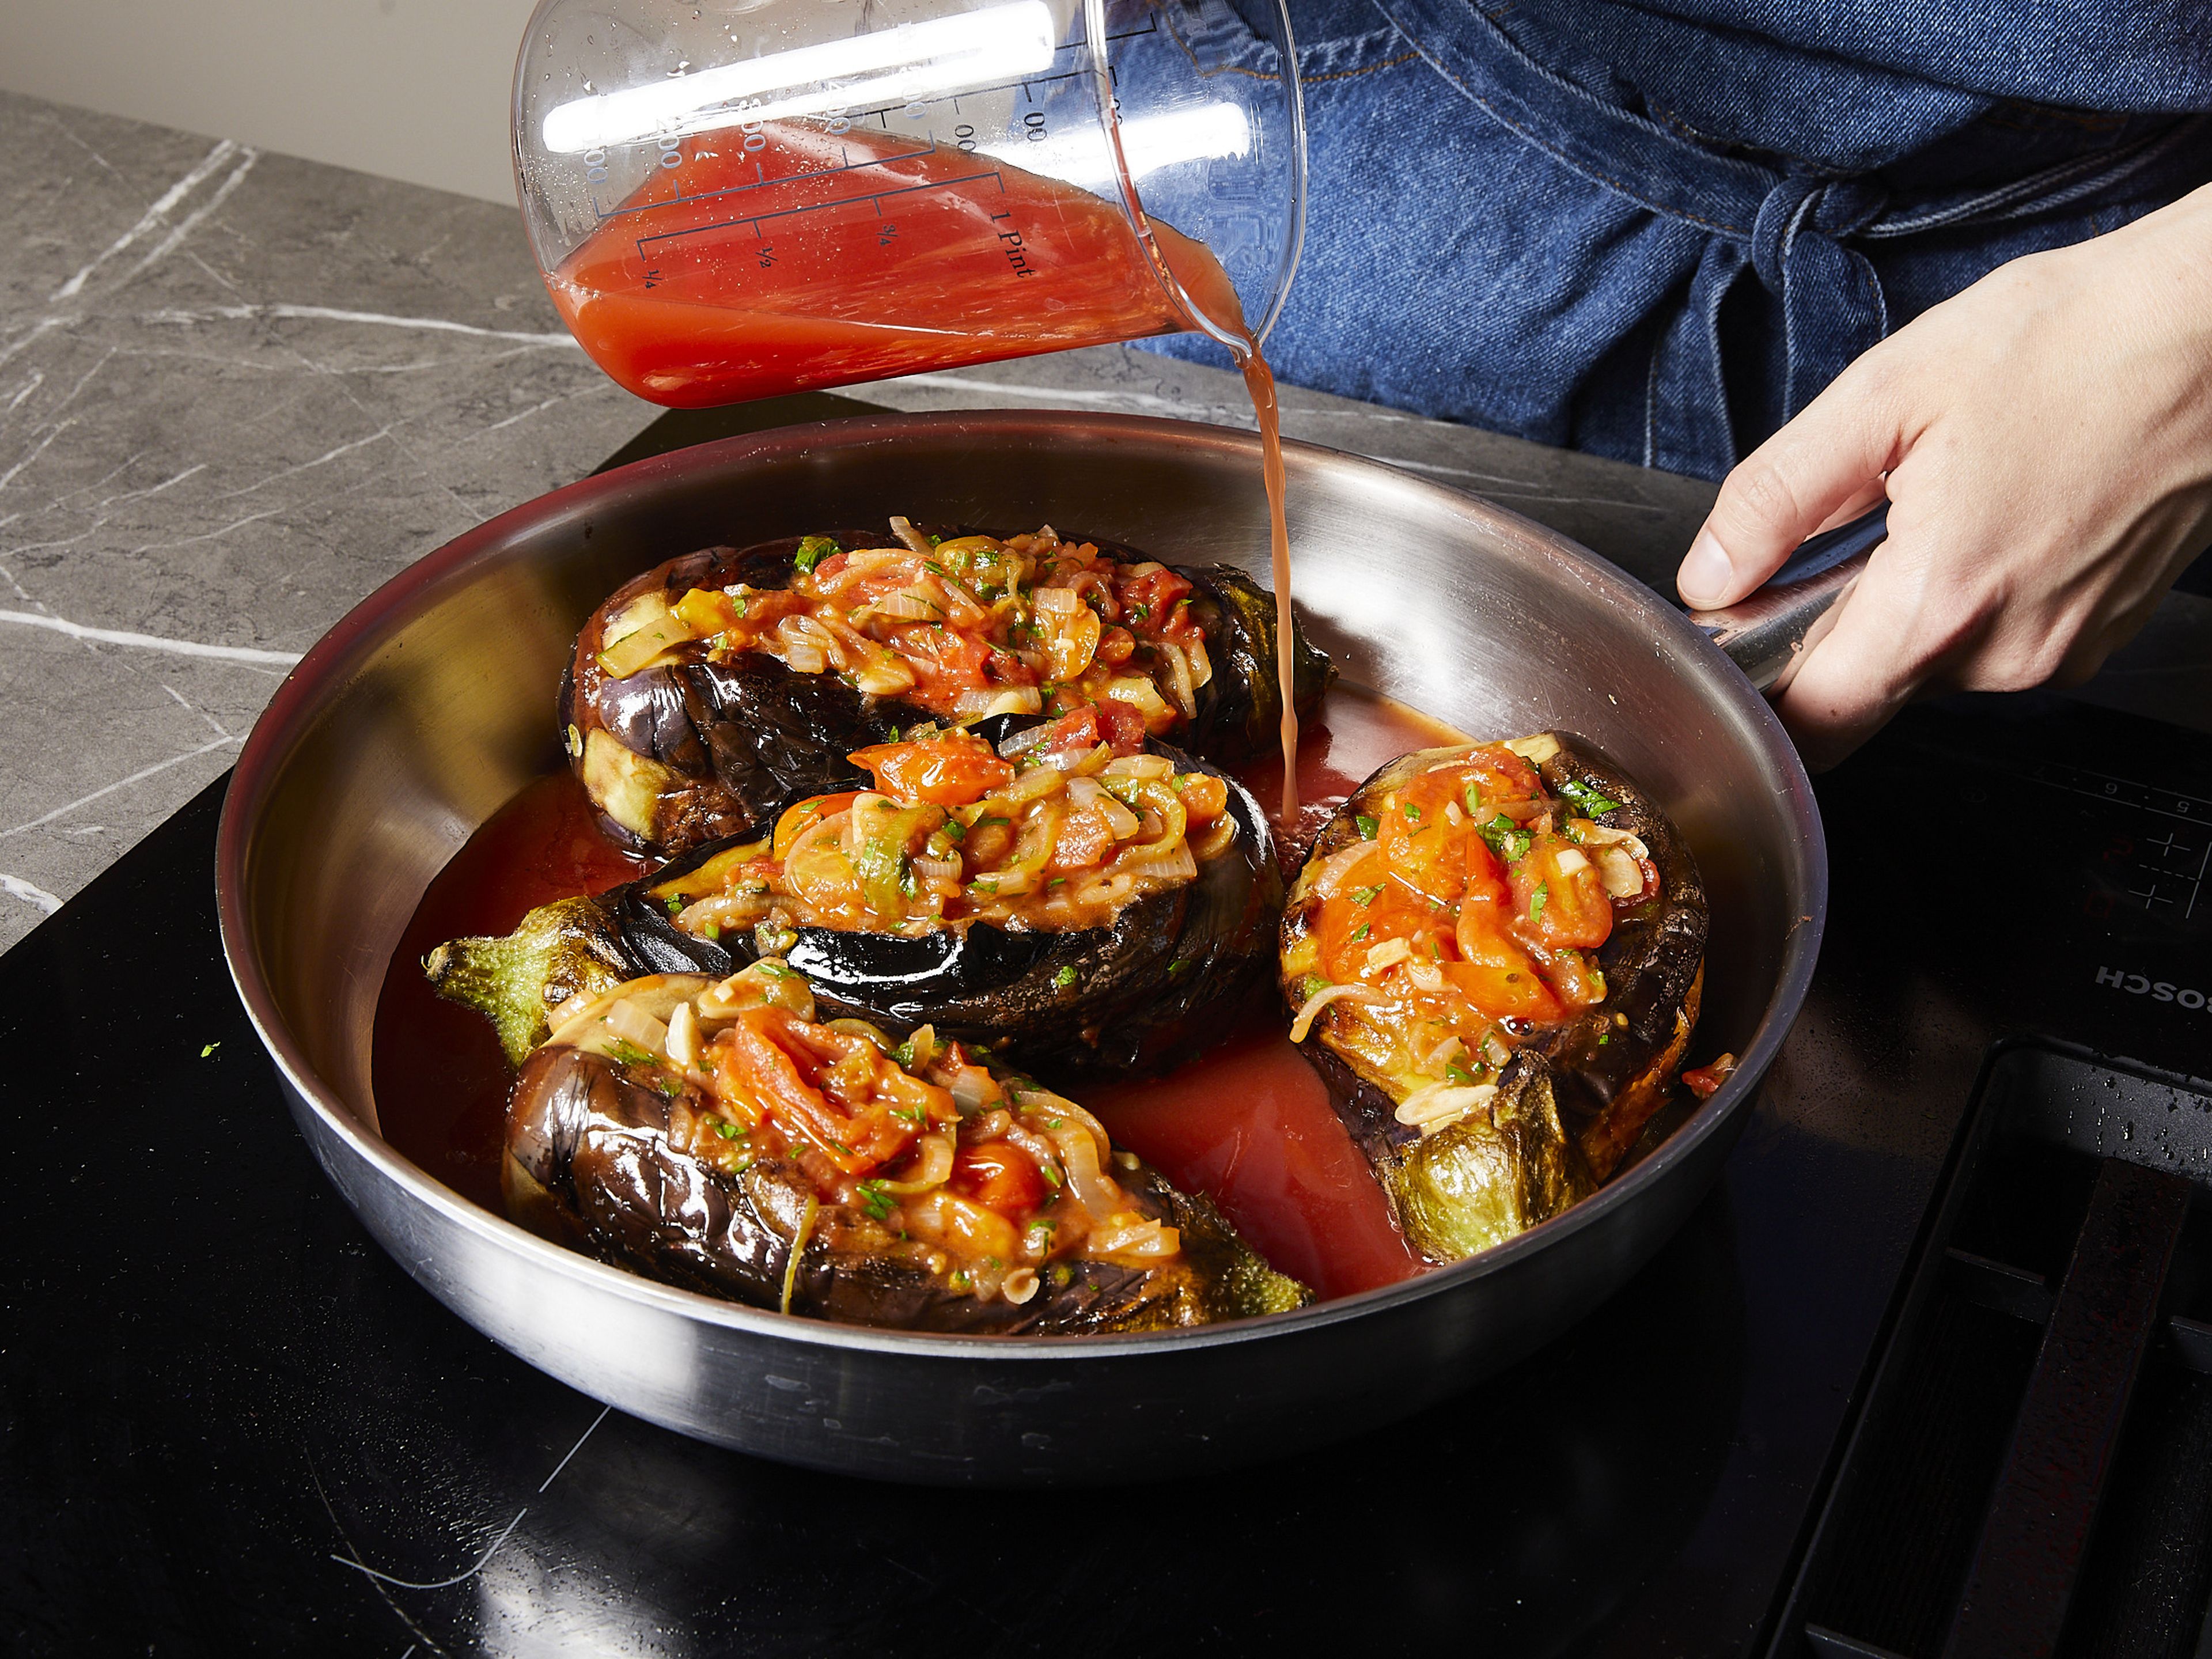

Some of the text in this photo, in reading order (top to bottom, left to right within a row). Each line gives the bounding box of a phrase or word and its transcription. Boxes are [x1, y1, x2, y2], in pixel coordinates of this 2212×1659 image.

[990, 209, 1036, 278] 1 Pint
[2094, 965, 2212, 1014] OSCH
